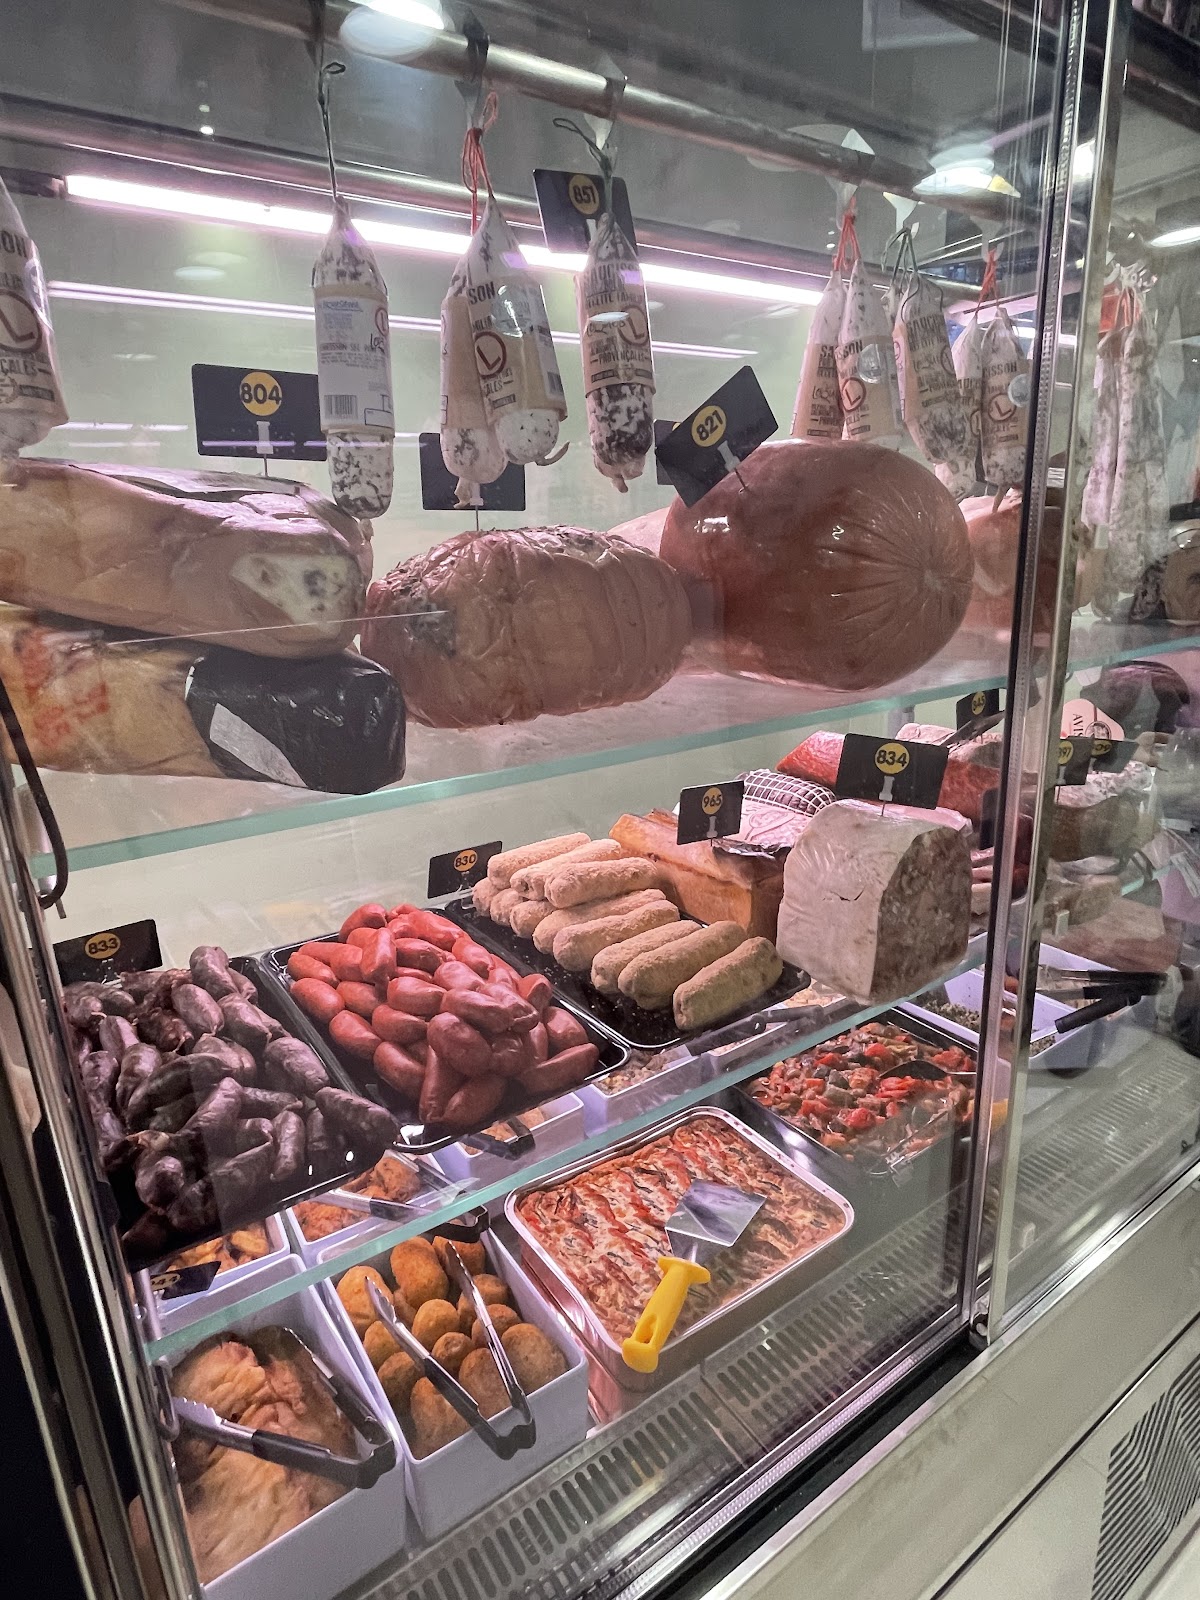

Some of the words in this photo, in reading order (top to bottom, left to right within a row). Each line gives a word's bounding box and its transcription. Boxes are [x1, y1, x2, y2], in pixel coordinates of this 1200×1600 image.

[572, 184, 597, 204] 851
[240, 382, 283, 405] 804
[696, 409, 724, 442] 821
[876, 749, 908, 768] 834
[703, 794, 723, 808] 965
[455, 853, 477, 868] 830
[88, 937, 119, 954] 833
